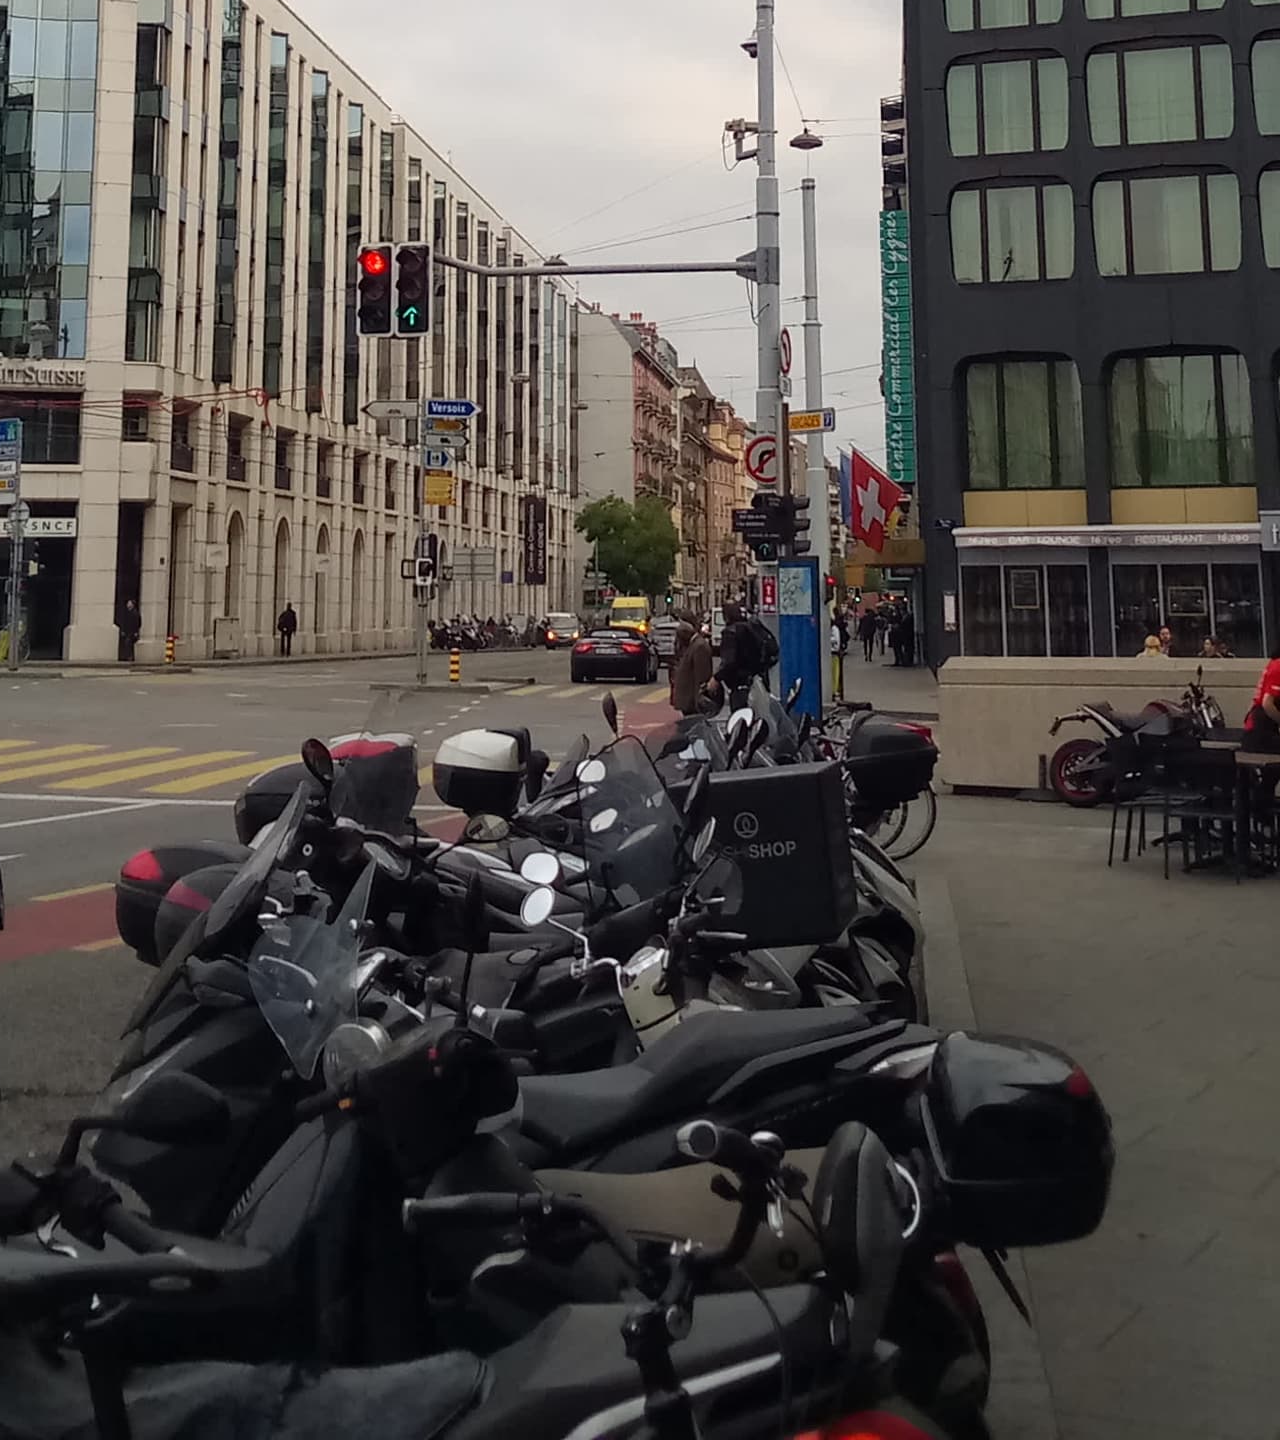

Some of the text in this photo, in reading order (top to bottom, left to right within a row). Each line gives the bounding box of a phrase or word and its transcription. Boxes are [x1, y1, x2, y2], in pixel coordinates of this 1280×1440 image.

[882, 210, 908, 274] Cygnes
[883, 312, 902, 417] Commercial
[22, 366, 87, 387] SUISSE
[431, 402, 467, 413] Versoix
[888, 421, 904, 482] Centre
[31, 520, 74, 531] SNCF
[1134, 533, 1205, 545] RESTAURANT
[748, 840, 797, 859] SHOP
